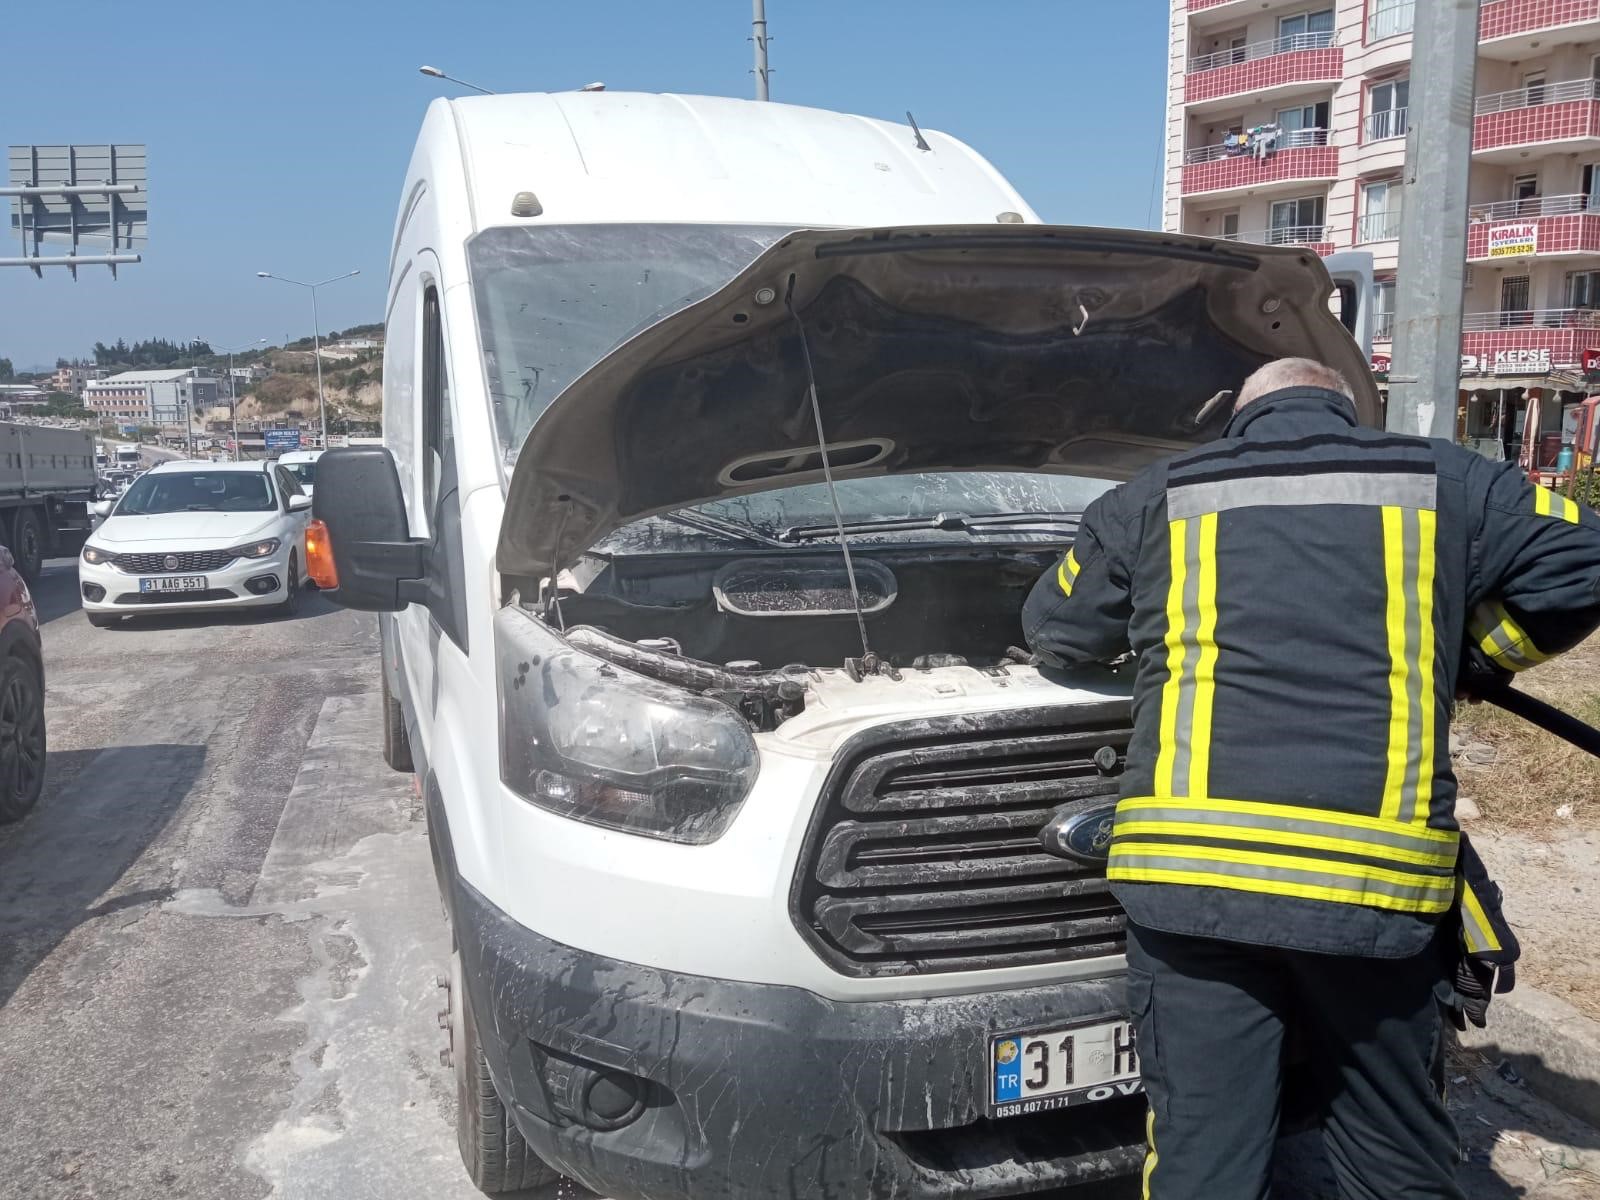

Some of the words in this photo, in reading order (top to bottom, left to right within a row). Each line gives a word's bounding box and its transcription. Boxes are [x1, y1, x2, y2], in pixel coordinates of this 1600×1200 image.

[1495, 349, 1550, 362] KEPSE
[146, 580, 157, 589] 31
[162, 578, 179, 589] AAG
[183, 577, 201, 588] 551
[1025, 1035, 1074, 1090] 31
[998, 1074, 1018, 1089] TR
[1086, 1081, 1145, 1101] OV
[996, 1104, 1021, 1118] 0530
[1023, 1101, 1041, 1113] 407
[1044, 1099, 1055, 1110] 71
[1058, 1097, 1069, 1107] 71
